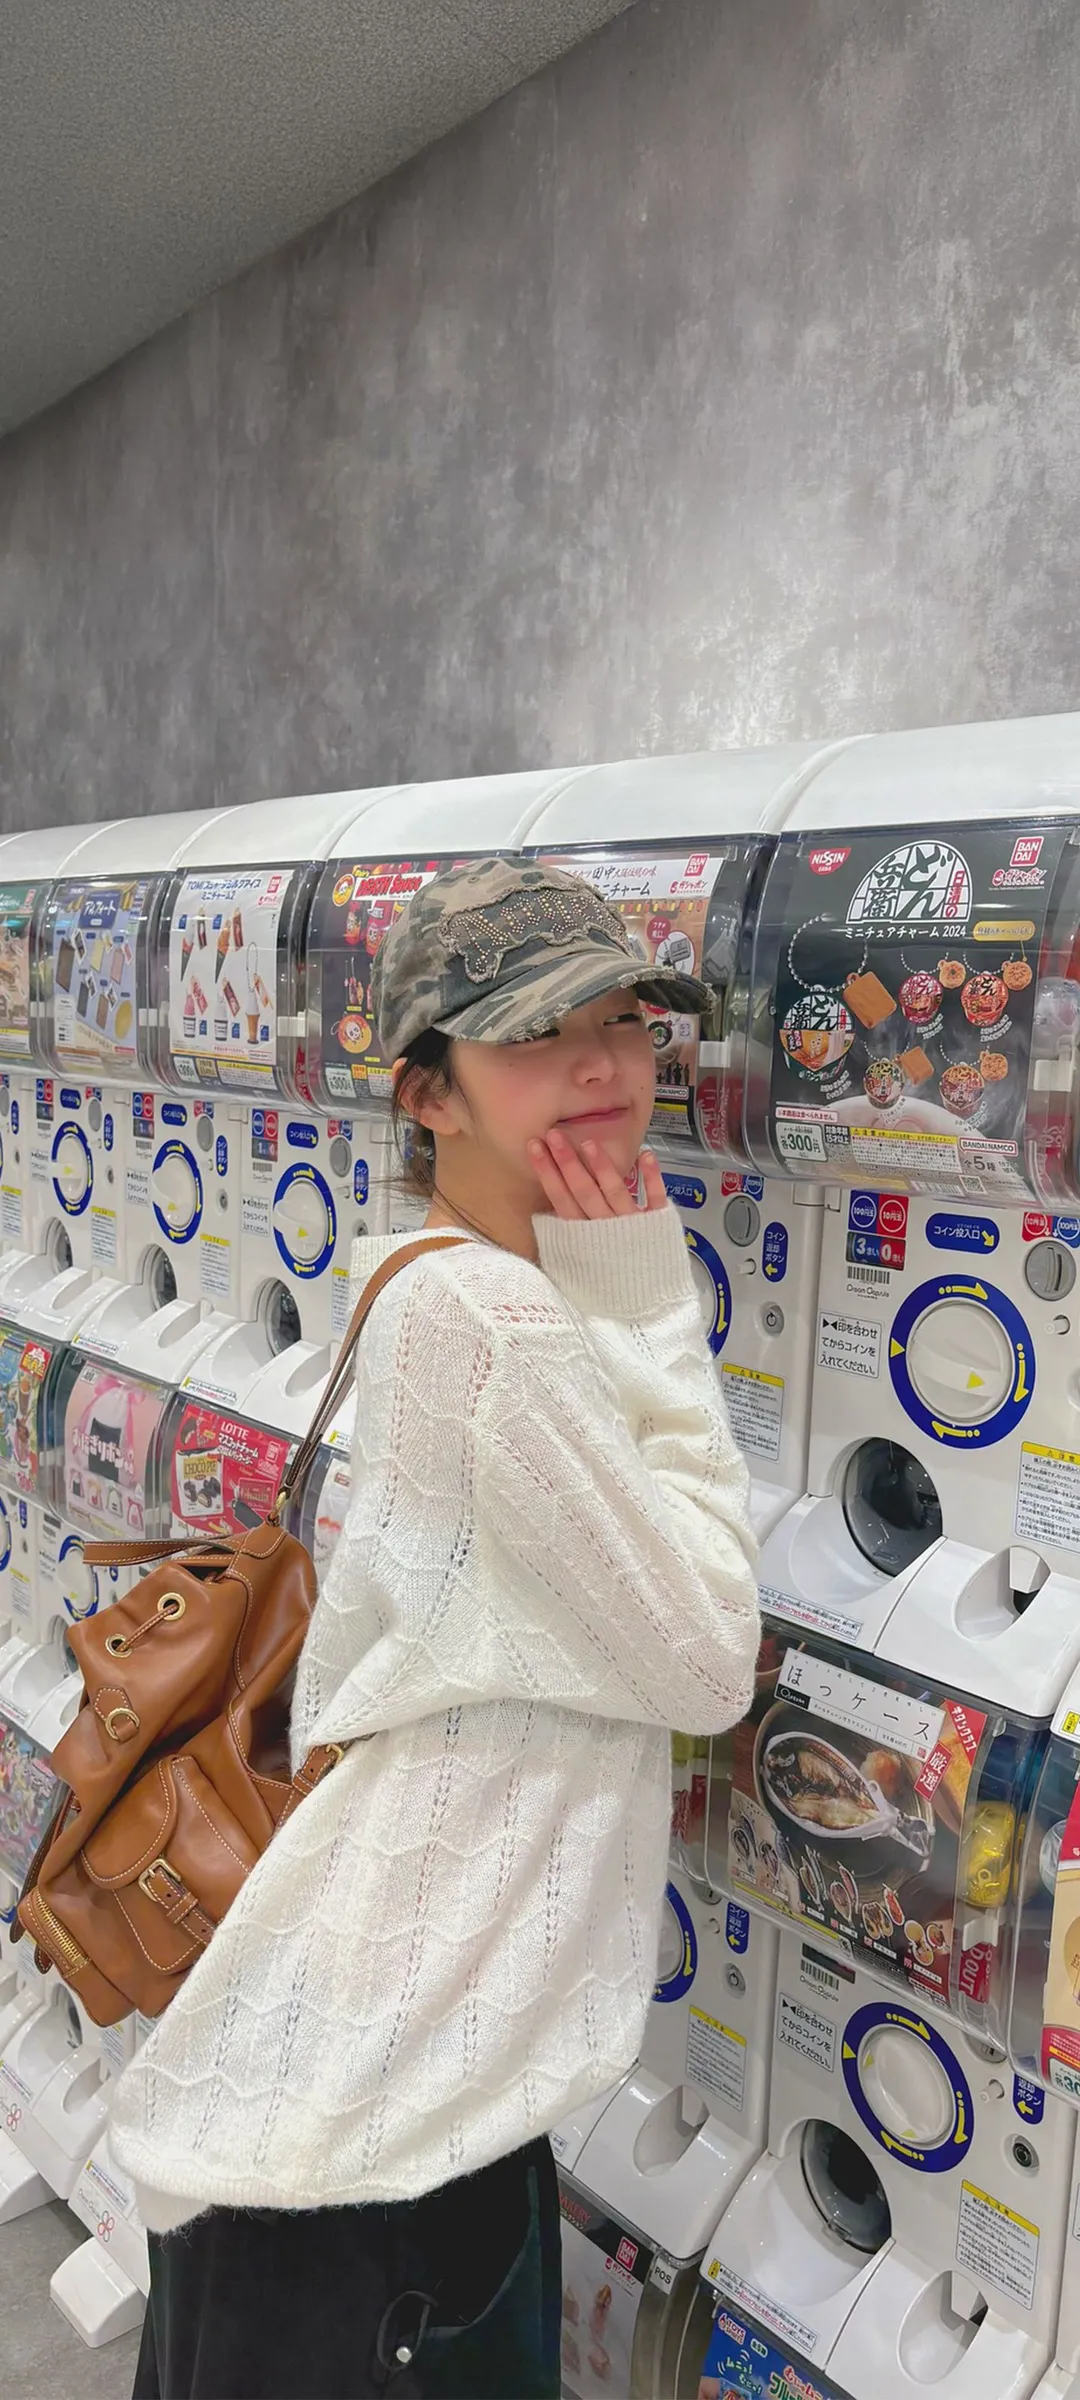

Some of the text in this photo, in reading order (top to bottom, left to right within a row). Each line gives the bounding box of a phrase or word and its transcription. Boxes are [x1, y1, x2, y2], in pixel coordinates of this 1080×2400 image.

[1018, 842, 1039, 852] BAN
[811, 851, 846, 865] NISSIN
[1014, 852, 1033, 861] DAI
[845, 925, 940, 939] ミニチュアチャーム
[942, 924, 967, 938] 2024
[934, 1225, 980, 1240] コイン投入口
[838, 1321, 878, 1339] 印を合わせ
[822, 1337, 876, 1357] てからコインを
[820, 1354, 876, 1375] 入れてください。
[221, 1421, 249, 1440] LOTTE
[919, 1750, 949, 1792] 厳選
[782, 2014, 832, 2052] てからコインを
[780, 2031, 833, 2068] 入れてください。
[655, 2267, 672, 2285] POS
[727, 2319, 745, 2338] TOYS
